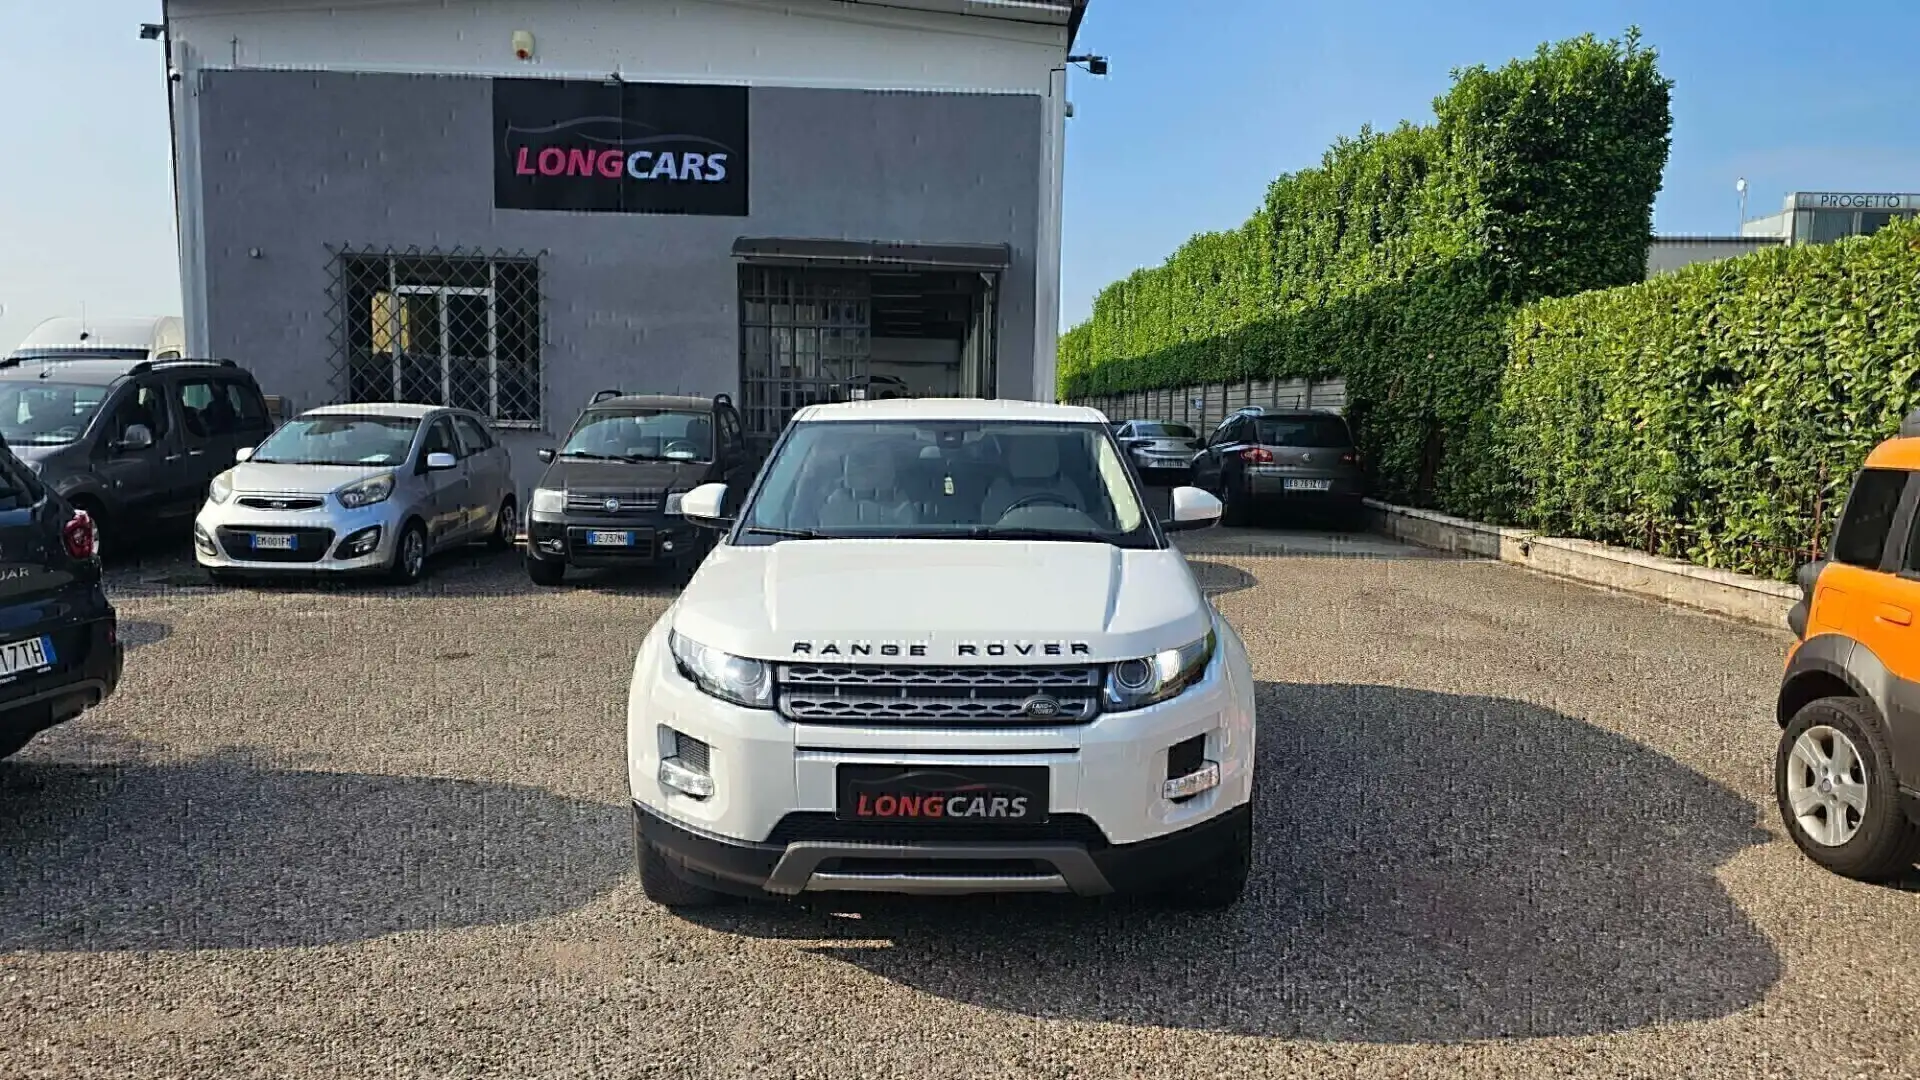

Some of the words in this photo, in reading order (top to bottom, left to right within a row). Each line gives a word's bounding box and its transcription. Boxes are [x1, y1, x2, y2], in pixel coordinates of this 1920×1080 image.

[516, 147, 728, 181] LONGCARS
[1820, 194, 1900, 208] PROGETTO
[792, 642, 927, 657] RANGE
[957, 643, 1090, 657] ROVER
[857, 794, 1028, 818] LONGCARS
